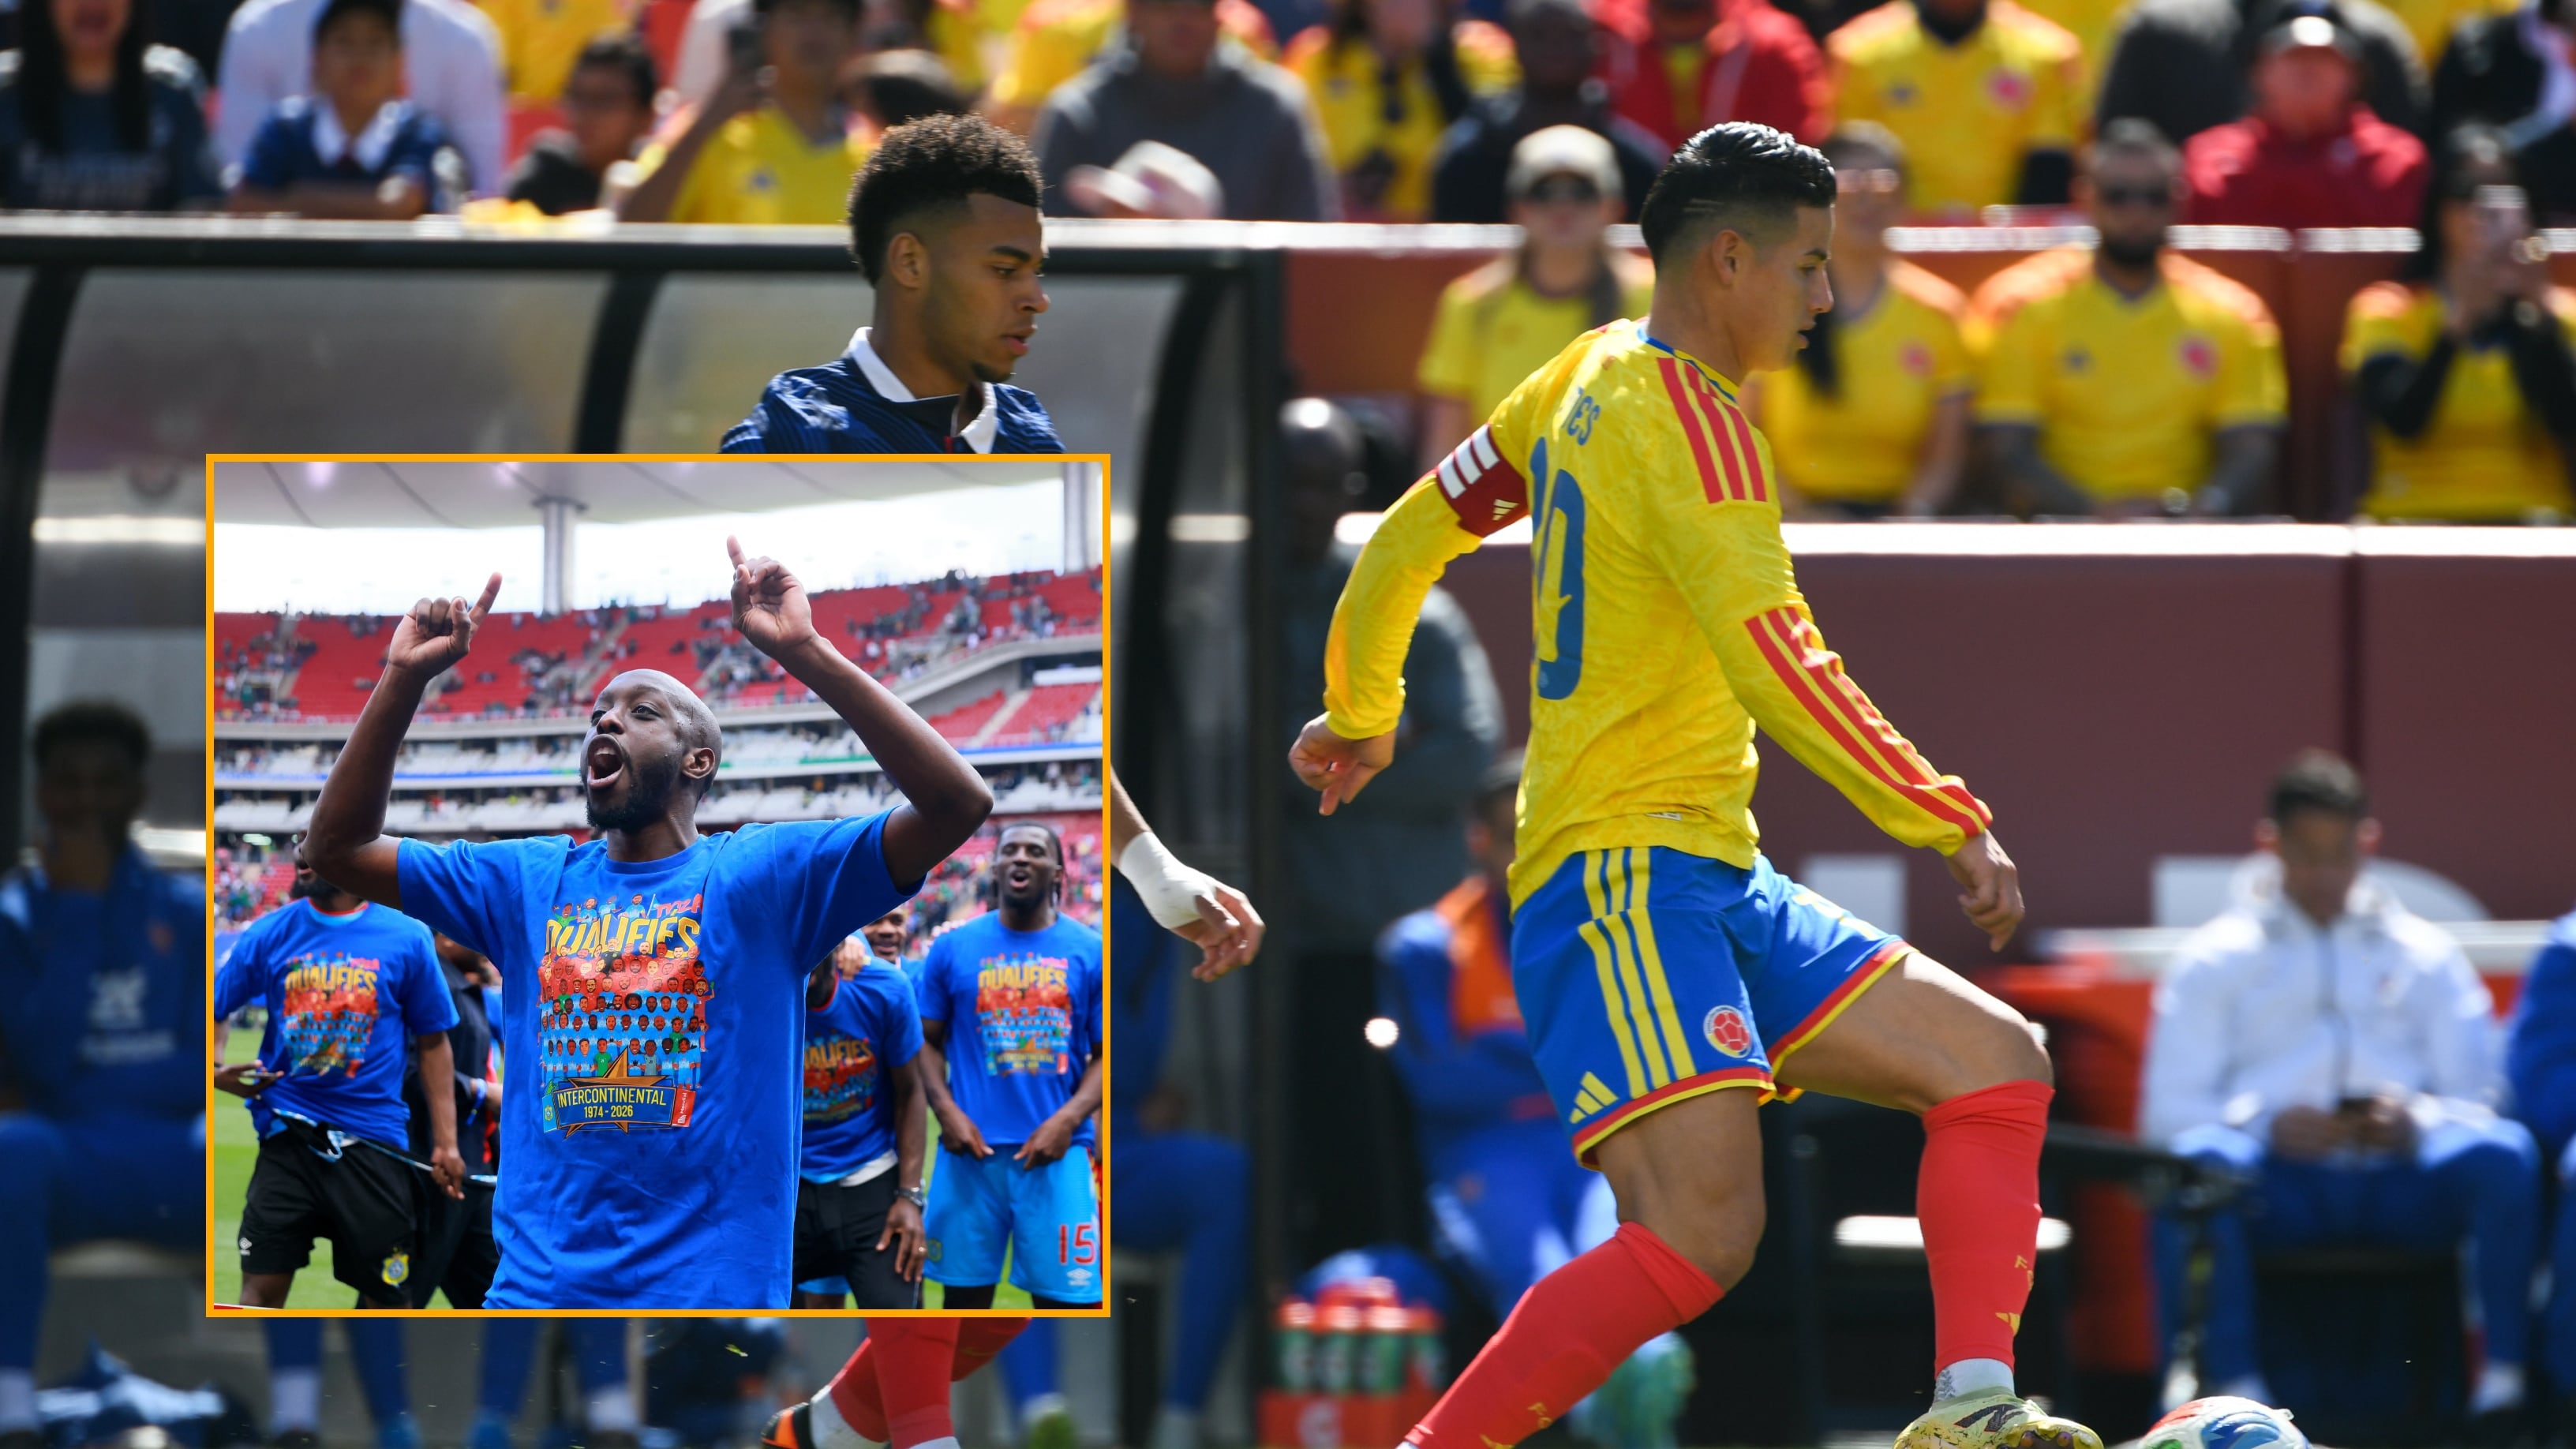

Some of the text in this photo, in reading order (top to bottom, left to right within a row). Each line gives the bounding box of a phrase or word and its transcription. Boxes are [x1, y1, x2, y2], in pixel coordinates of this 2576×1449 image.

[557, 1088, 667, 1108] INTERCONTINENTAL
[584, 1106, 604, 1118] 1974
[611, 1105, 634, 1118] 2026
[1059, 1223, 1096, 1265] 15
